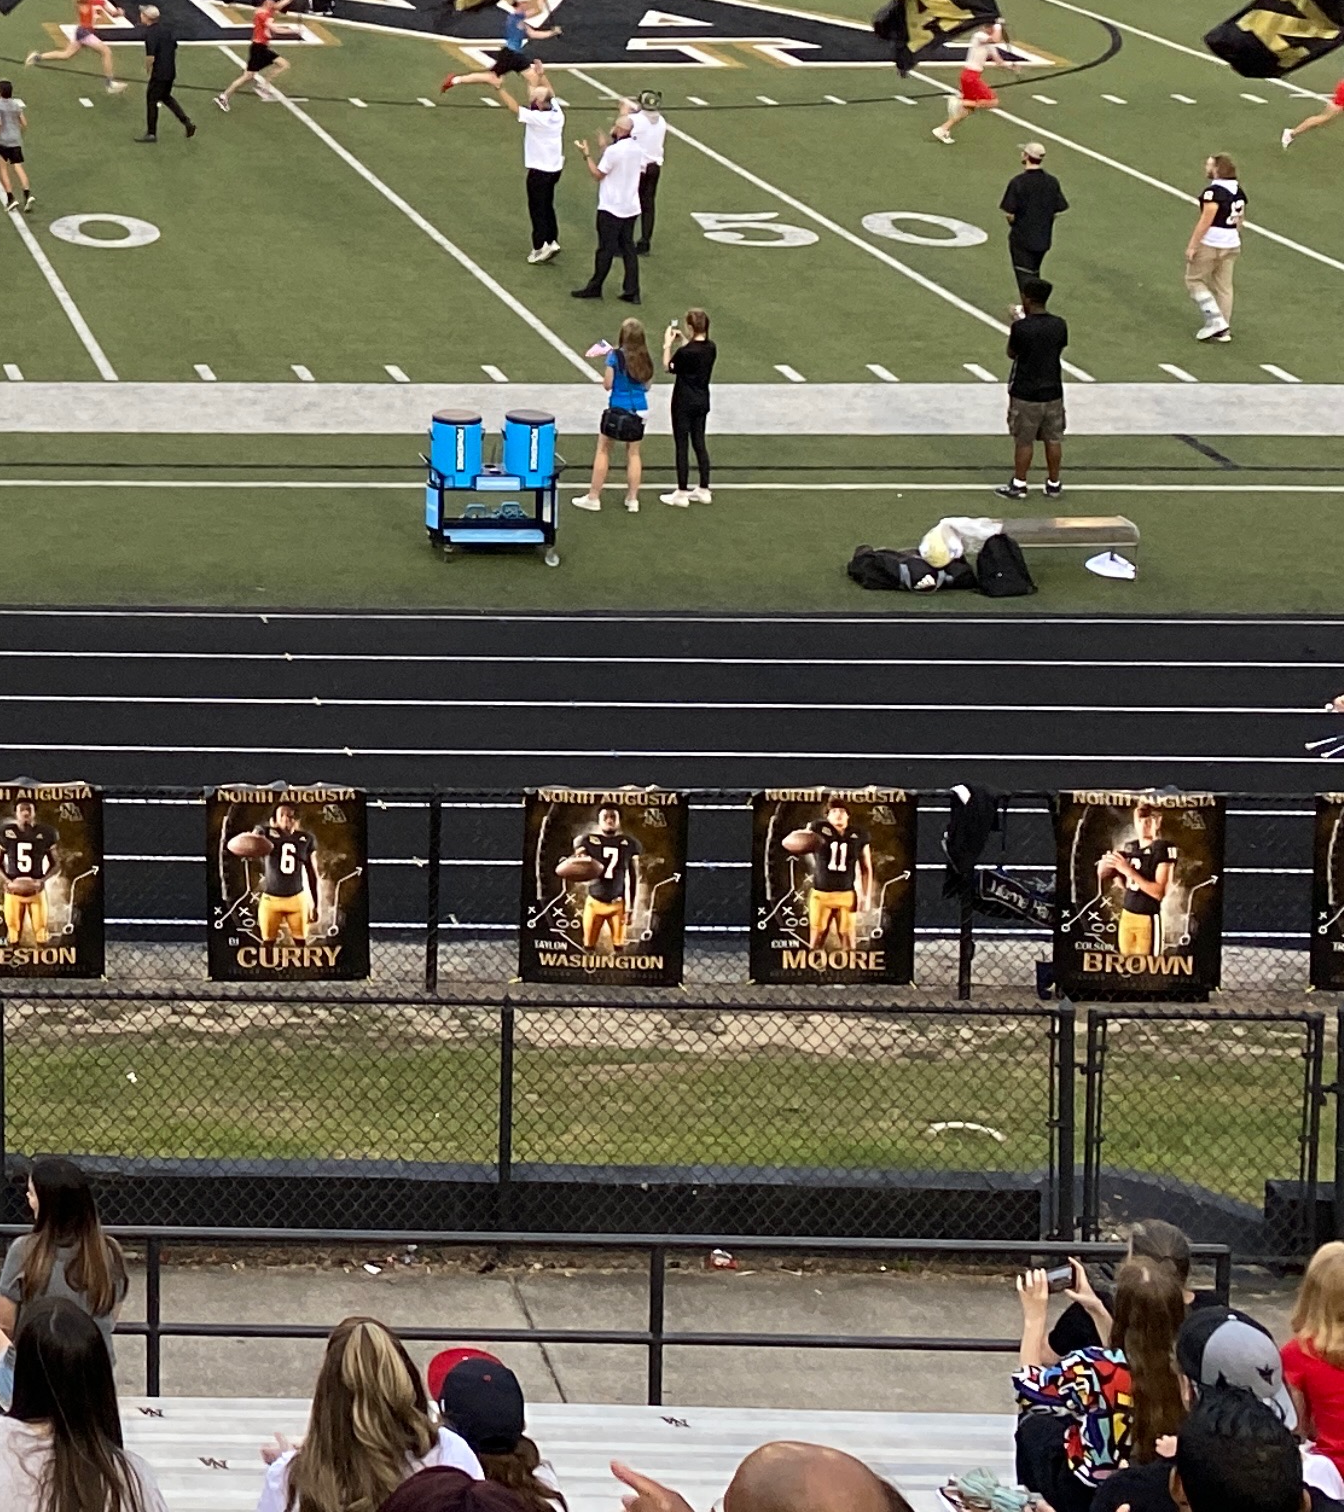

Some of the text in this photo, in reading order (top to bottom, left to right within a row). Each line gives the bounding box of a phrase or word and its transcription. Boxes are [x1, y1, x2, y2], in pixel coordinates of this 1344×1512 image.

[691, 211, 988, 247] 50
[16, 786, 93, 802] AUGUSTA
[217, 788, 356, 806] NORTH AUGUSTA
[600, 791, 679, 806] AUGUSTA
[16, 842, 34, 873] 5
[280, 843, 296, 875] 6
[602, 847, 619, 879] 7
[828, 840, 849, 872] 11
[236, 945, 344, 968] CURRY
[538, 951, 665, 971] WASHINGTON
[781, 950, 887, 971] MOORE
[1083, 953, 1194, 977] BROWN
